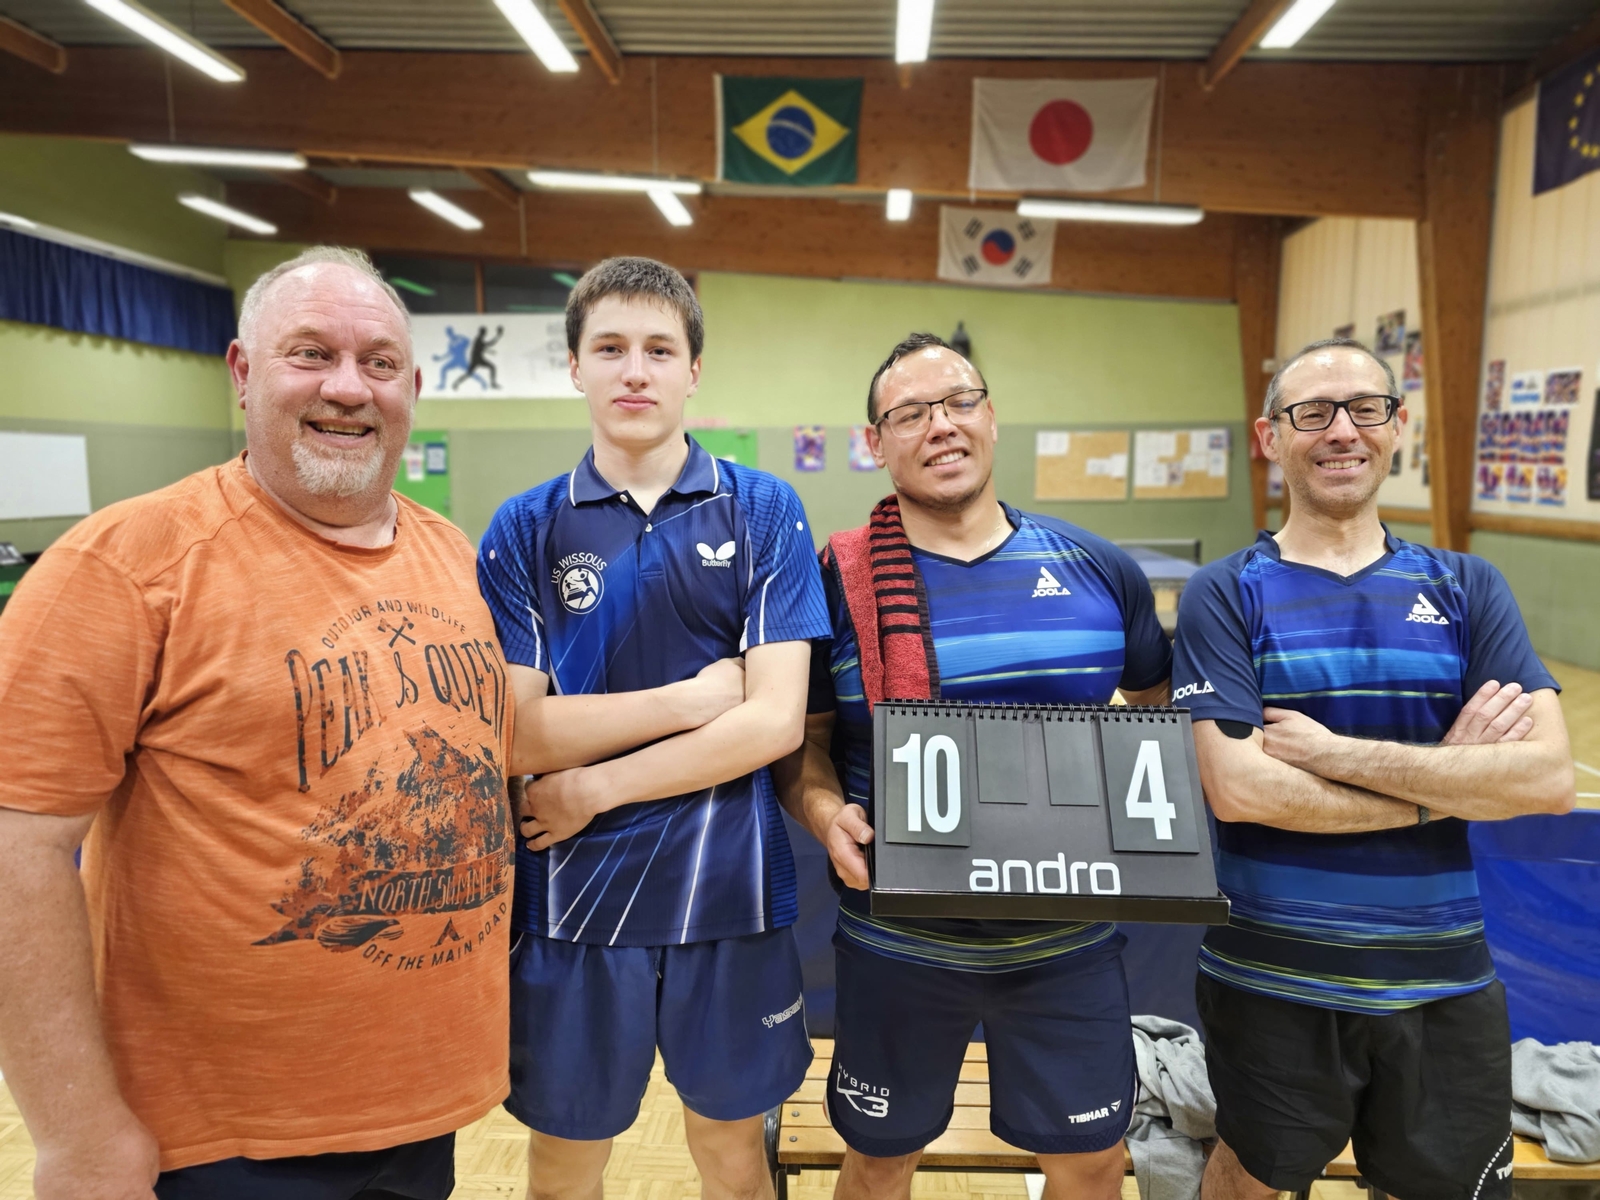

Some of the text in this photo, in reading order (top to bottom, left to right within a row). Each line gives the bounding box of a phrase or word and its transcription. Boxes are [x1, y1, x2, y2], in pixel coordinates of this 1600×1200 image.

[551, 552, 608, 584] US WISSOUS
[701, 559, 732, 568] Butterfly
[1031, 587, 1072, 598] JOOLA
[321, 599, 466, 649] OUTDOOR AND WILDLIFE
[1405, 612, 1450, 625] JOOLA
[1171, 680, 1215, 703] JOOLA
[284, 649, 387, 793] PEAK
[424, 638, 506, 751] QUEST
[892, 733, 962, 833] 10
[1125, 740, 1177, 840] 4
[358, 858, 497, 912] NORTH SUMMIT
[969, 852, 1122, 895] andro
[362, 901, 507, 971] OFF THE MAIN ROAD
[838, 1061, 890, 1097] HYBRID
[1068, 1107, 1110, 1124] TIBHAR
